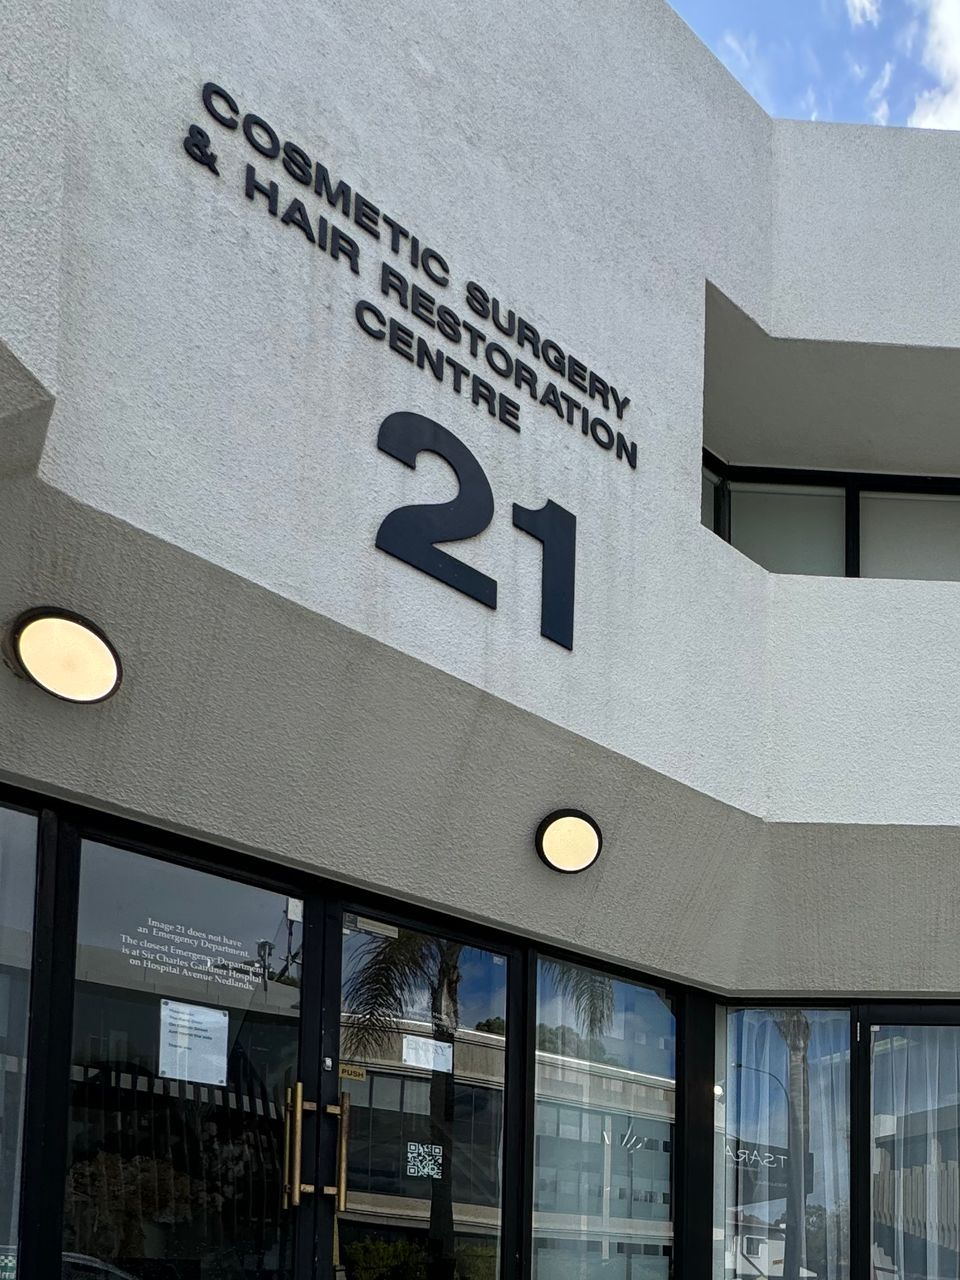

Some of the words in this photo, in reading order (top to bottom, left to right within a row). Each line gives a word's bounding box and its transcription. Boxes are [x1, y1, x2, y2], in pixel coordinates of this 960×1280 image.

[201, 81, 450, 287] COSMETIC
[465, 279, 631, 420] SURGERY
[183, 124, 220, 176] &
[244, 164, 361, 275] HAIR
[380, 262, 638, 470] RESTORATION
[354, 299, 521, 433] CENTRE
[375, 411, 577, 651] 21
[147, 917, 175, 932] Image
[175, 924, 185, 934] 21
[187, 927, 206, 938] does
[208, 933, 222, 942] not
[223, 935, 242, 948] have
[152, 928, 199, 948] Emergency
[201, 939, 250, 958] Department.
[120, 934, 138, 945] The
[139, 937, 169, 952] closest
[170, 946, 215, 965] Emergency
[217, 956, 264, 974] Department
[121, 945, 130, 954] is
[131, 948, 140, 956] at
[142, 950, 155, 960] Sir
[156, 953, 189, 967] Charles
[190, 960, 228, 976] Gairdner
[228, 969, 262, 984] Hospital
[129, 957, 141, 966] on
[143, 959, 180, 975] Hospital
[181, 968, 213, 982] Avenue
[214, 975, 255, 991] Nedlands.
[341, 1068, 364, 1078] PUSH
